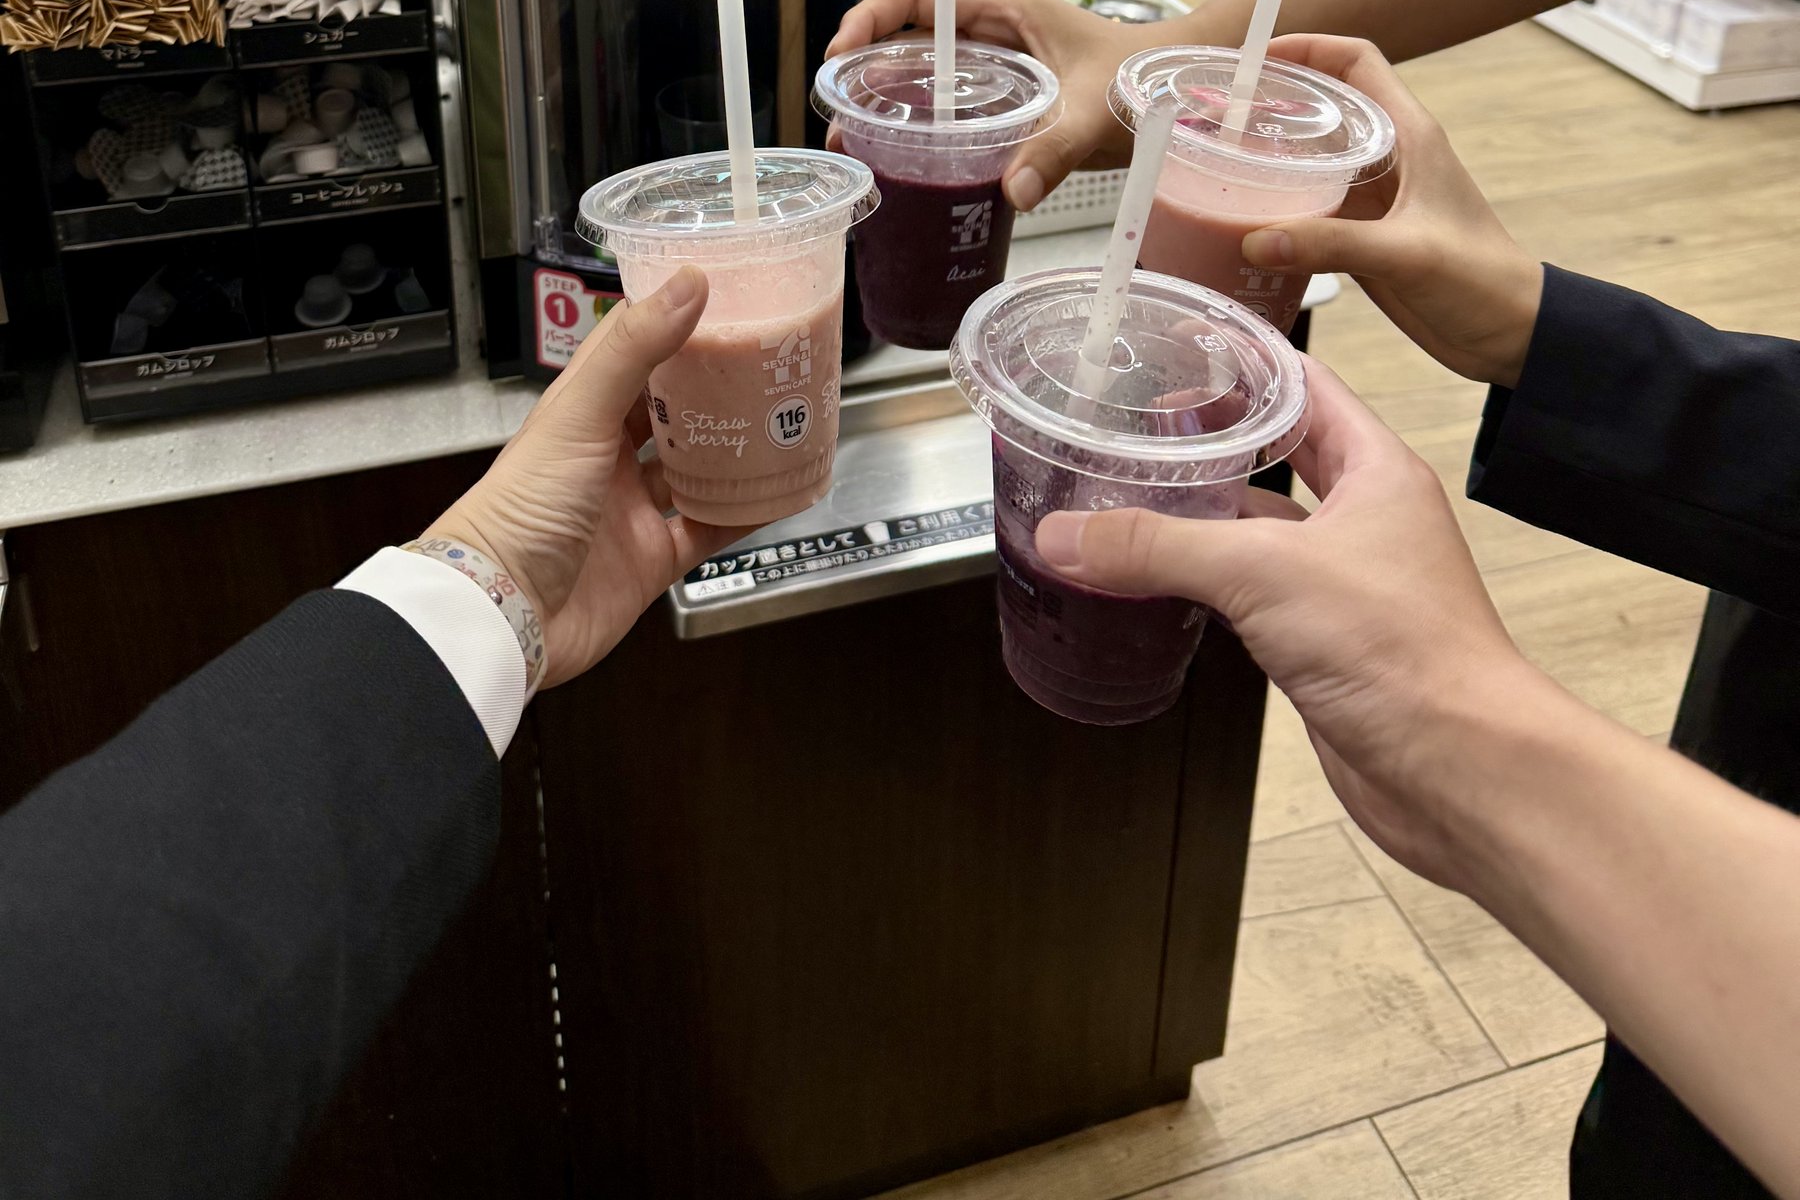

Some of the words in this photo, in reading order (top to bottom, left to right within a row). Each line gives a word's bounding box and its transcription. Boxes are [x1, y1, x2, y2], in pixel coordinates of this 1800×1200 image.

[303, 29, 359, 46] シュガー
[545, 277, 577, 292] STEP
[325, 327, 400, 350] ガムシロップ
[137, 354, 216, 377] ガムシロップ
[764, 382, 792, 397] SEVEN
[681, 410, 751, 431] Straw
[776, 405, 806, 430] 116
[688, 427, 749, 458] berry
[783, 425, 803, 440] kcal
[699, 531, 856, 580] カップ置きとして
